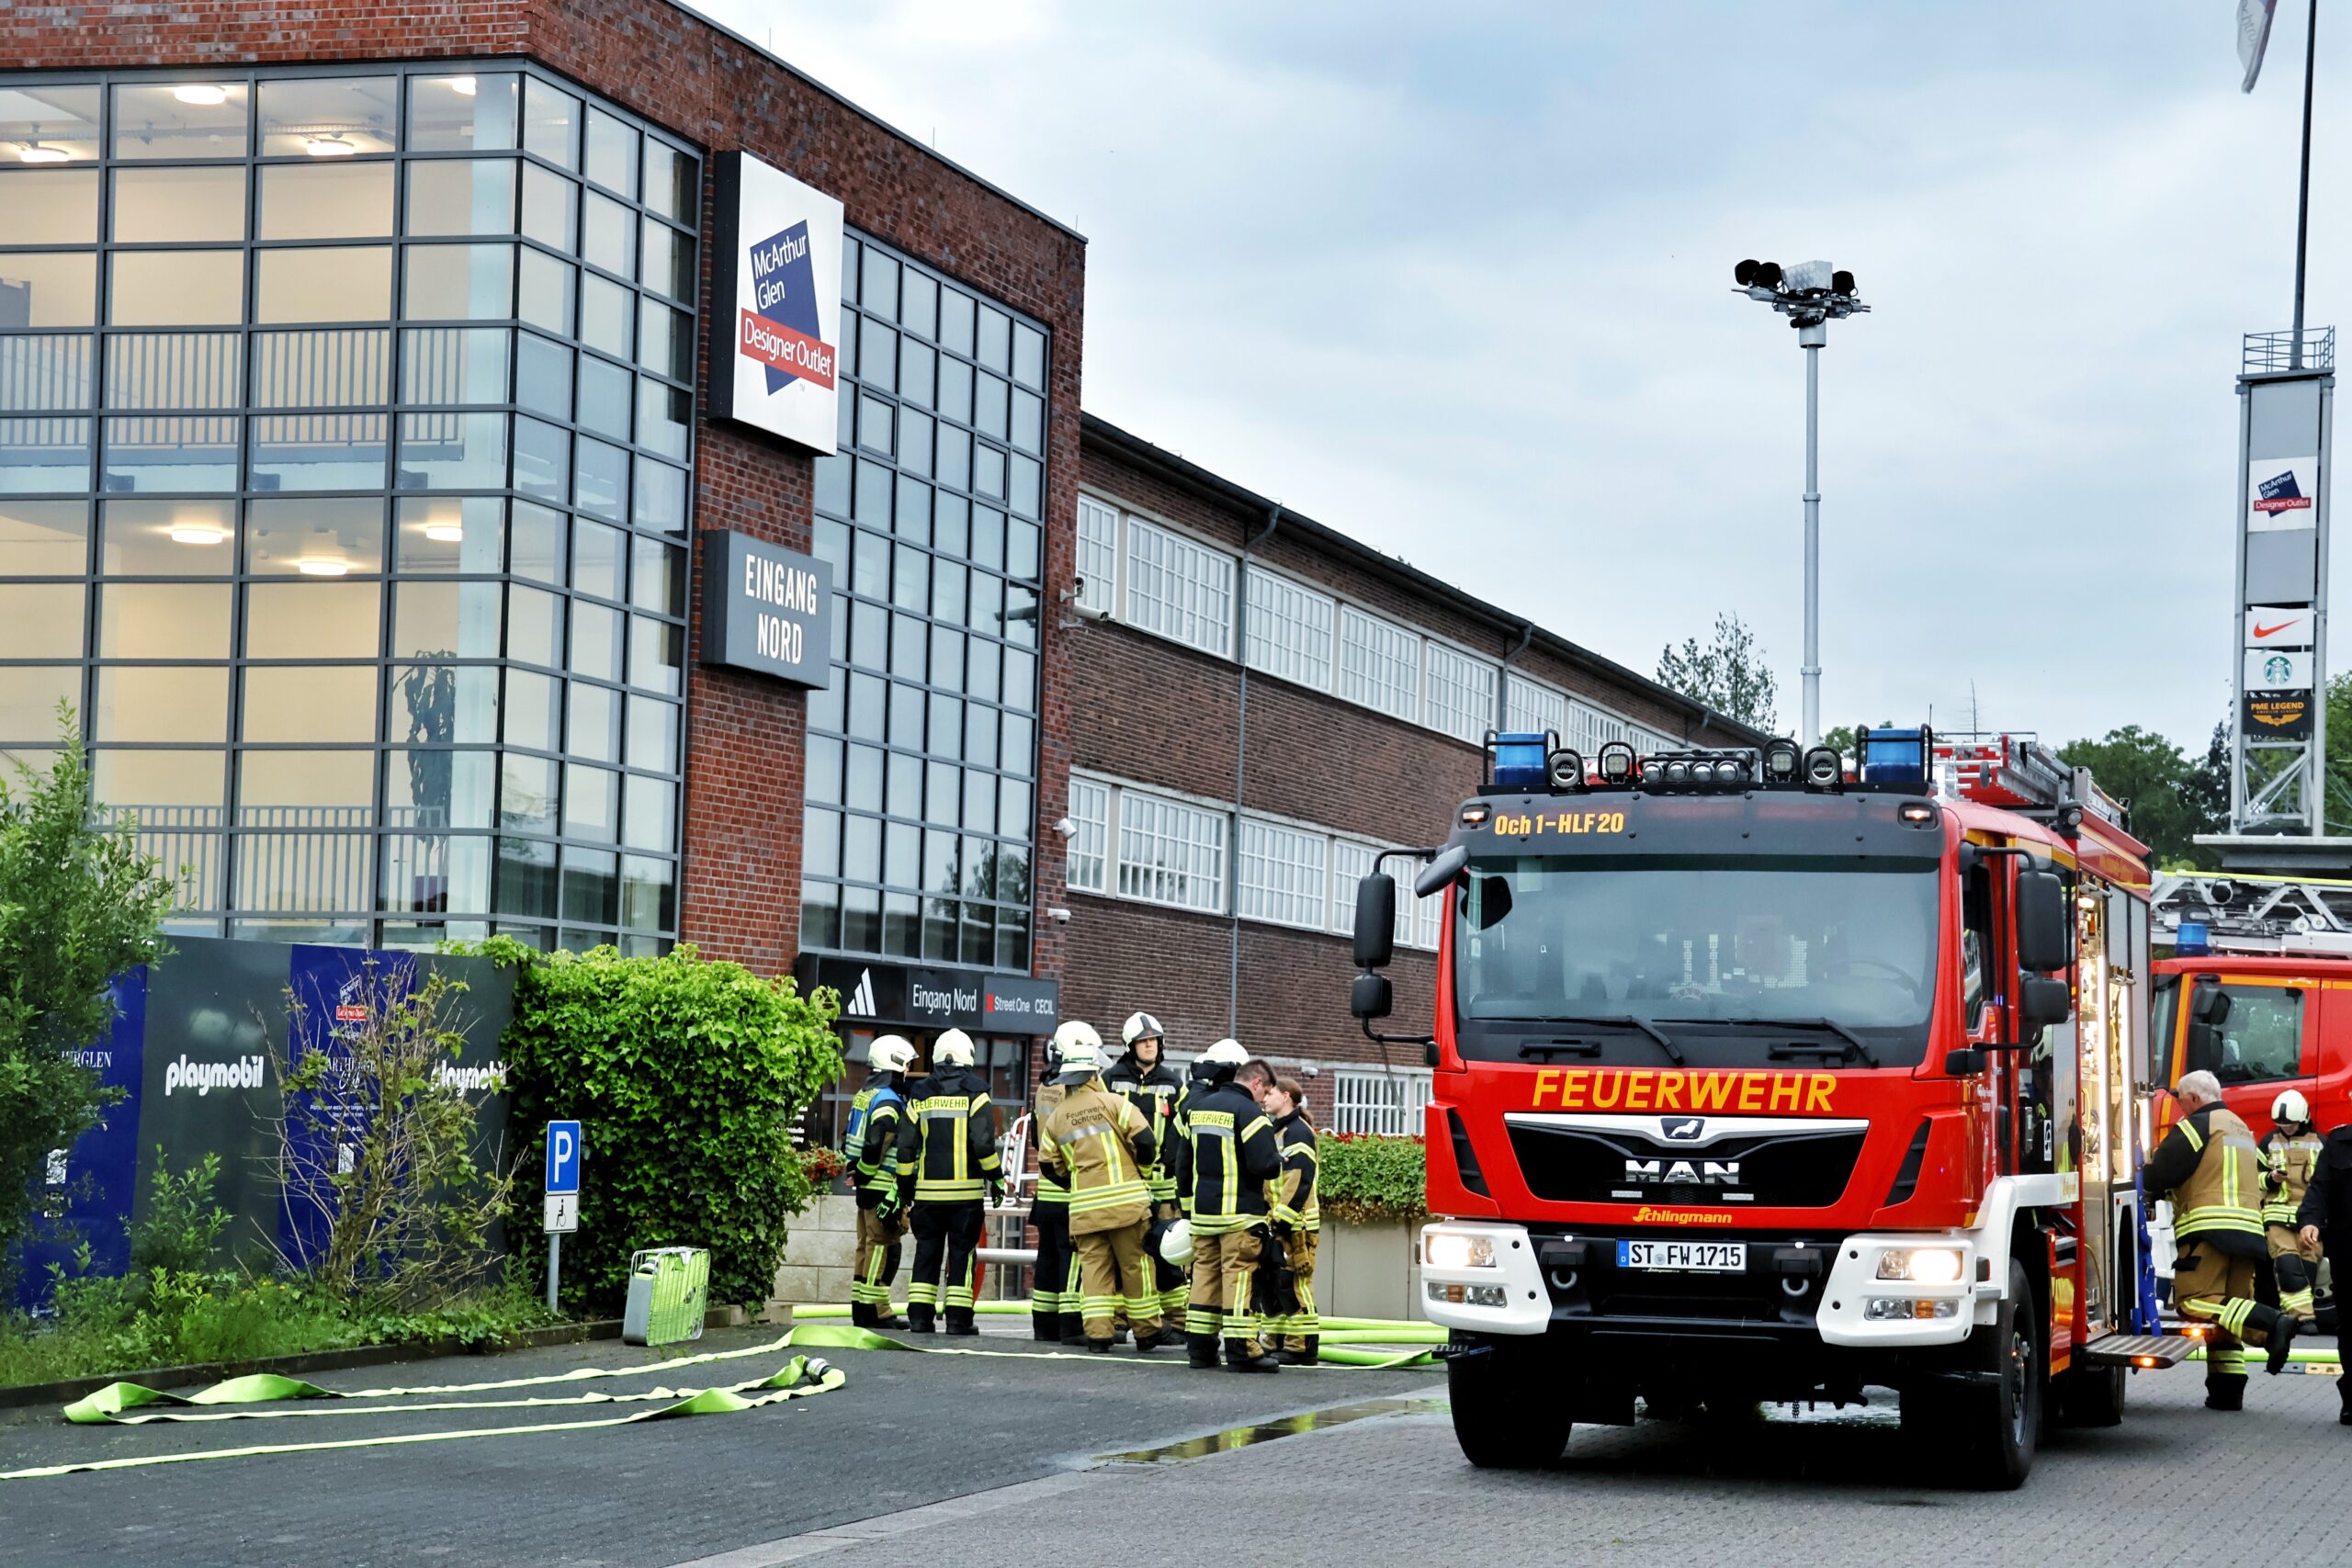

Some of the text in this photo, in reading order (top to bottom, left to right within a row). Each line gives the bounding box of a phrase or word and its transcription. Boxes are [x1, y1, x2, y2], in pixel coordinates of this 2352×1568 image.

[753, 233, 807, 279] McArthur
[757, 278, 786, 310] Glen
[744, 317, 831, 378] Designer Outlet
[2260, 473, 2292, 492] McArthur
[2263, 488, 2279, 499] Glen
[2256, 499, 2309, 510] Designer Outlet
[745, 554, 817, 615] EINGANG
[757, 613, 803, 664] NORD
[2271, 702, 2304, 710] LEGEND
[1495, 815, 1532, 835] Och
[912, 984, 977, 1016] Eingang Nord
[994, 996, 1054, 1014] Street One CECIL
[165, 1054, 264, 1096] playmobil
[1532, 1069, 1837, 1111] FEUERWEHR
[915, 1097, 967, 1111] FEUERWEHR
[1066, 1105, 1106, 1120] Feuerwehr
[1071, 1113, 1102, 1126] Ochtrup
[554, 1131, 572, 1183] P
[1625, 1160, 1739, 1184] MAN
[1633, 1207, 1732, 1224] Schlingmann
[1631, 1244, 1741, 1267] ST FW 1715
